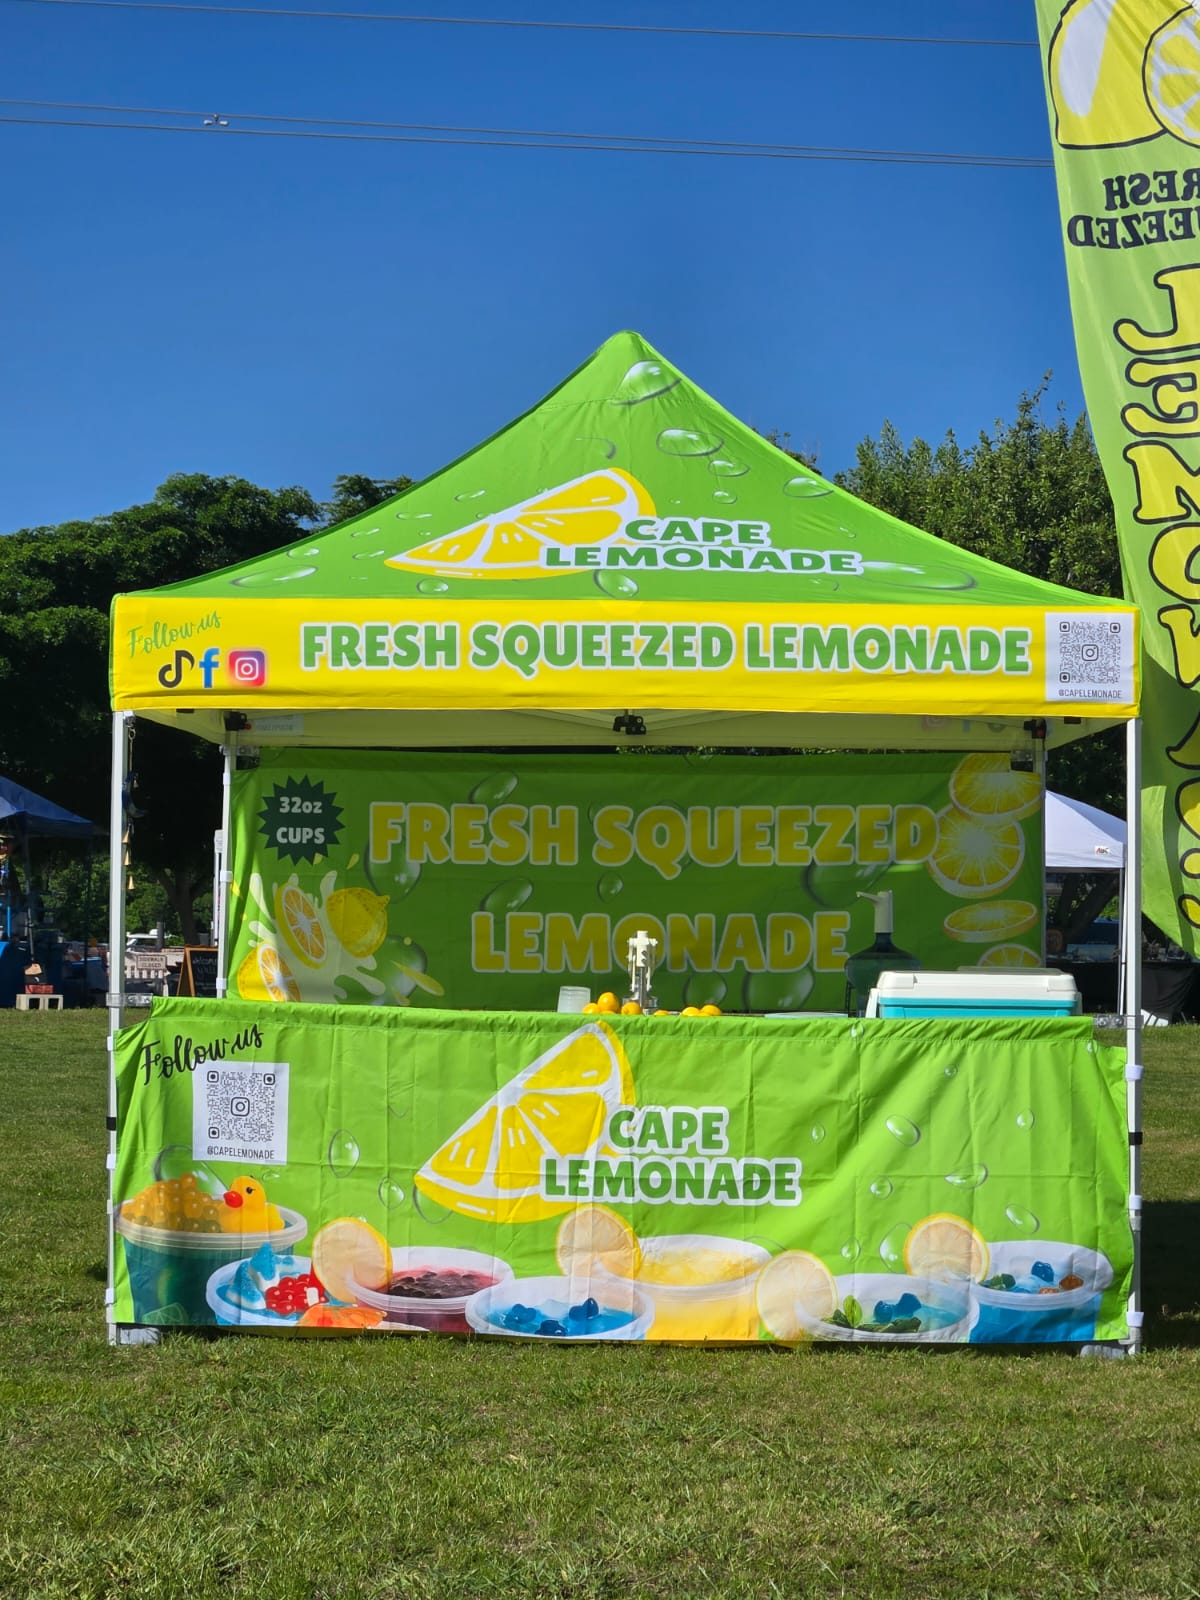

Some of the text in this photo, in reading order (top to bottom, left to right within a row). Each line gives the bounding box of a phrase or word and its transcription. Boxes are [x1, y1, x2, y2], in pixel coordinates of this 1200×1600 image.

[624, 517, 767, 546] CAPE
[544, 545, 857, 573] LEMONADE
[127, 609, 222, 659] Follow us
[302, 622, 1030, 677] FRESH SQUEEZED LEMONADE
[1058, 689, 1122, 699] @CAPELEMONADE
[279, 796, 322, 814] 32oz
[276, 827, 325, 844] CUPS
[369, 802, 940, 880] FRESH SQUEEZED
[472, 911, 852, 973] LEMONADE
[140, 1023, 264, 1086] Follow us
[608, 1109, 725, 1150] CAPE
[206, 1145, 275, 1160] @CAPELEMONADE
[544, 1157, 798, 1202] LEMONADE
